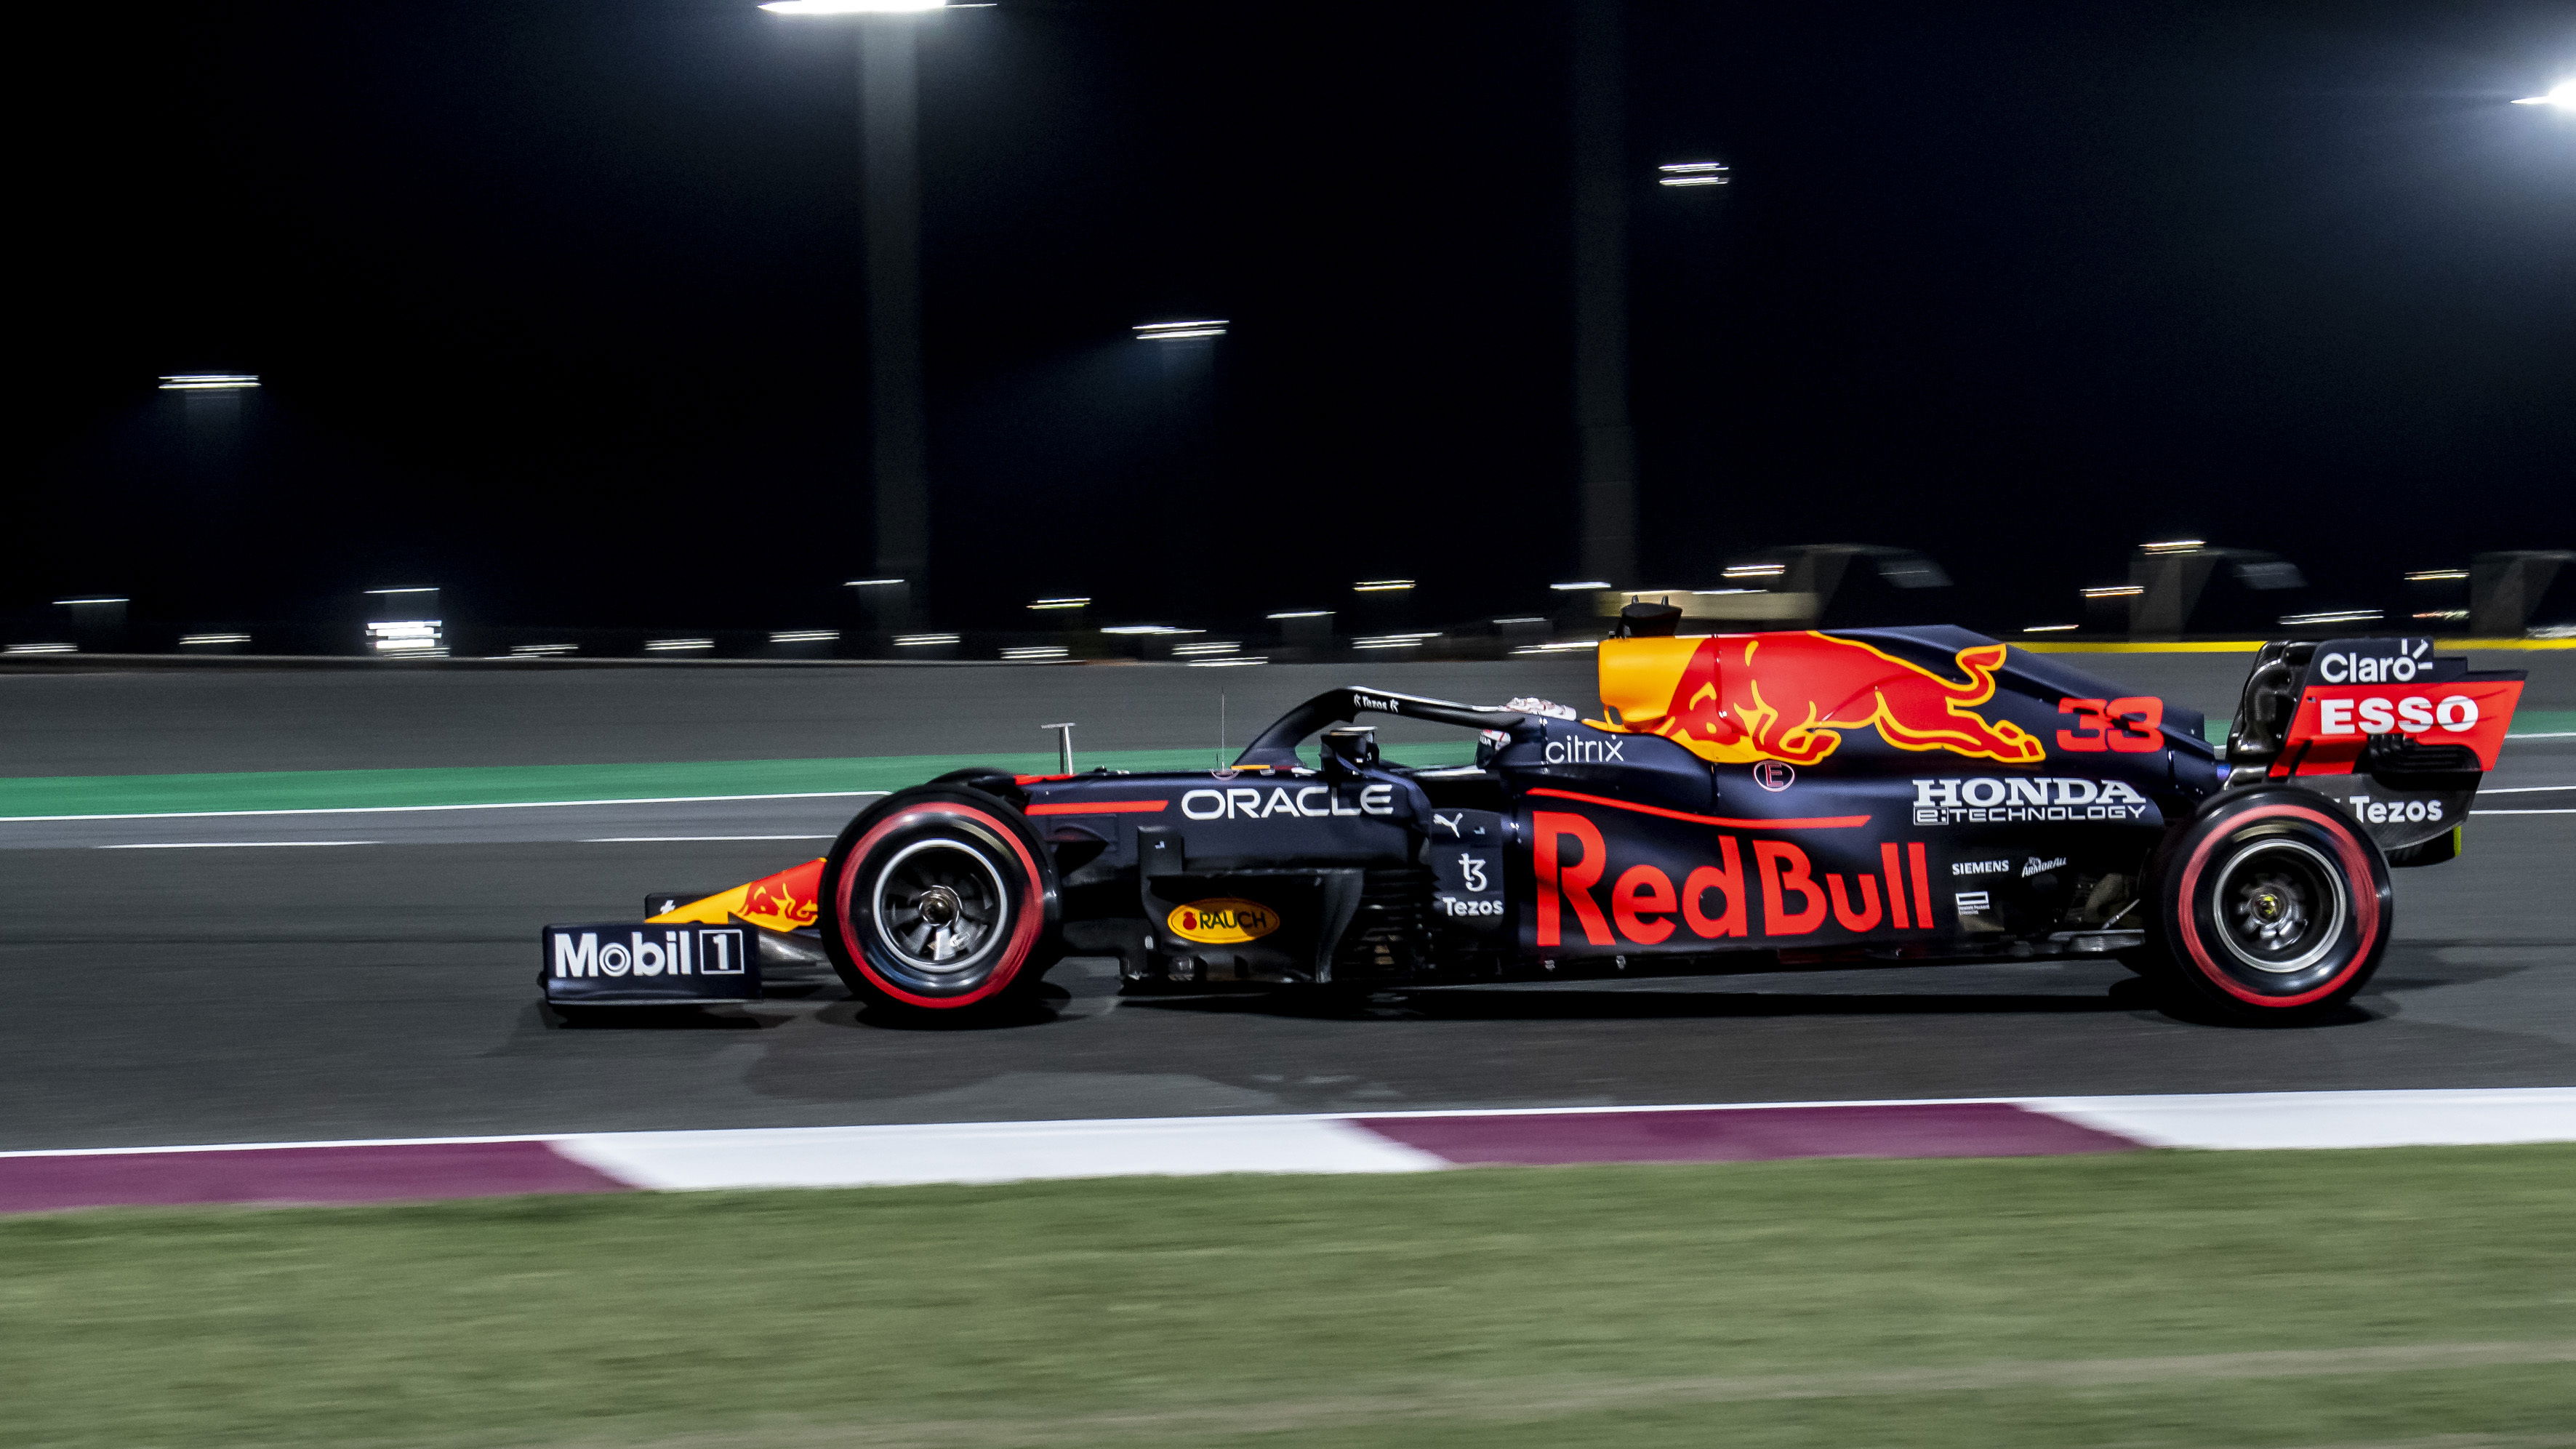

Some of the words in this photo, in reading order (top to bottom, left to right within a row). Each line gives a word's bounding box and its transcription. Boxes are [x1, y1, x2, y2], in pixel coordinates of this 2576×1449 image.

[2320, 651, 2416, 683] Claro
[2056, 697, 2164, 752] 33
[2320, 695, 2479, 735] ESSO
[1545, 734, 1624, 764] citrix
[1181, 784, 1395, 820] ORACLE
[1912, 778, 2146, 807] HONDA
[2349, 795, 2444, 824] Tezos
[1951, 859, 2010, 875] SIEMENS
[1200, 910, 1267, 930] RAUCH
[1442, 896, 1504, 917] Tezos
[554, 930, 691, 977] Mobil
